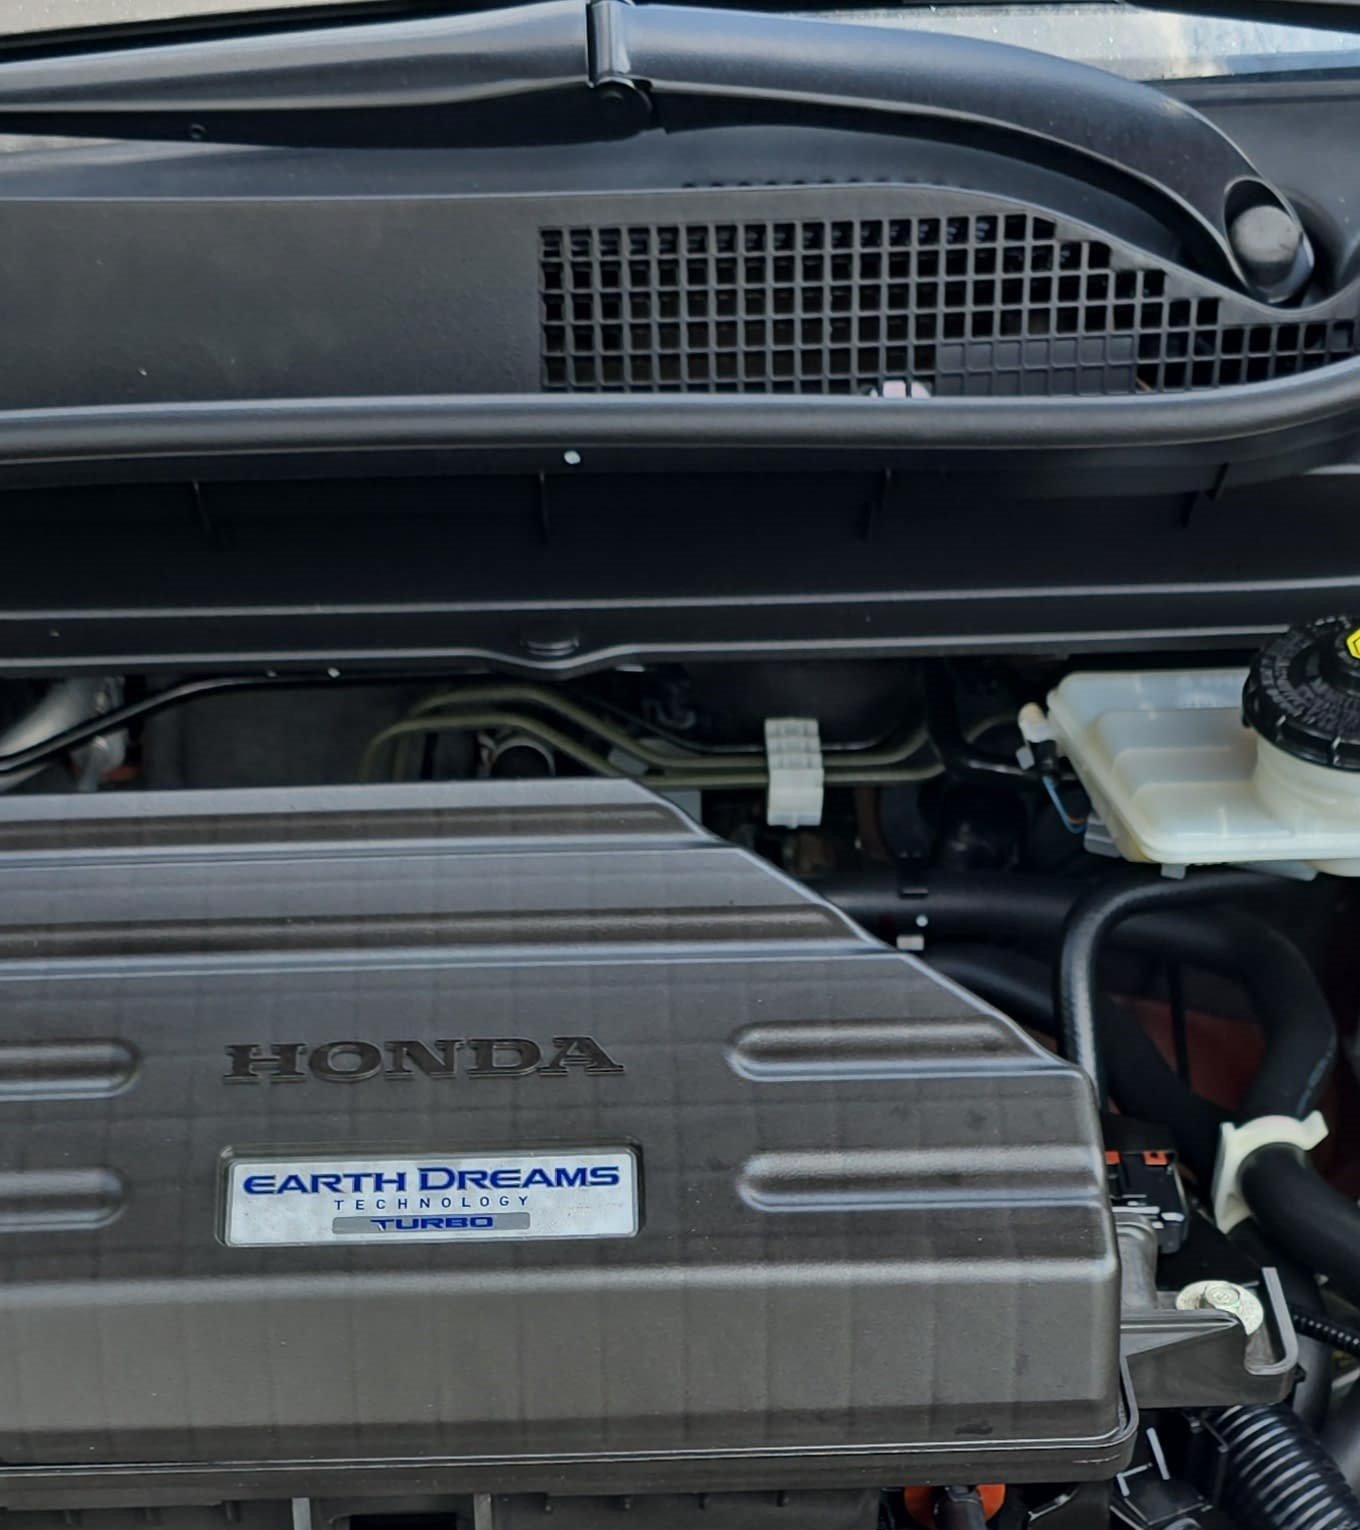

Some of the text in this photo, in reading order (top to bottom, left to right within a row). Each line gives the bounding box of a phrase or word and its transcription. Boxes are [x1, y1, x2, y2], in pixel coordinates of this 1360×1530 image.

[224, 1036, 625, 1083] HONDA
[243, 1166, 621, 1195] EARTH DREAMS
[334, 1195, 529, 1211] TECHNOLOGY
[370, 1215, 494, 1231] TURBO
